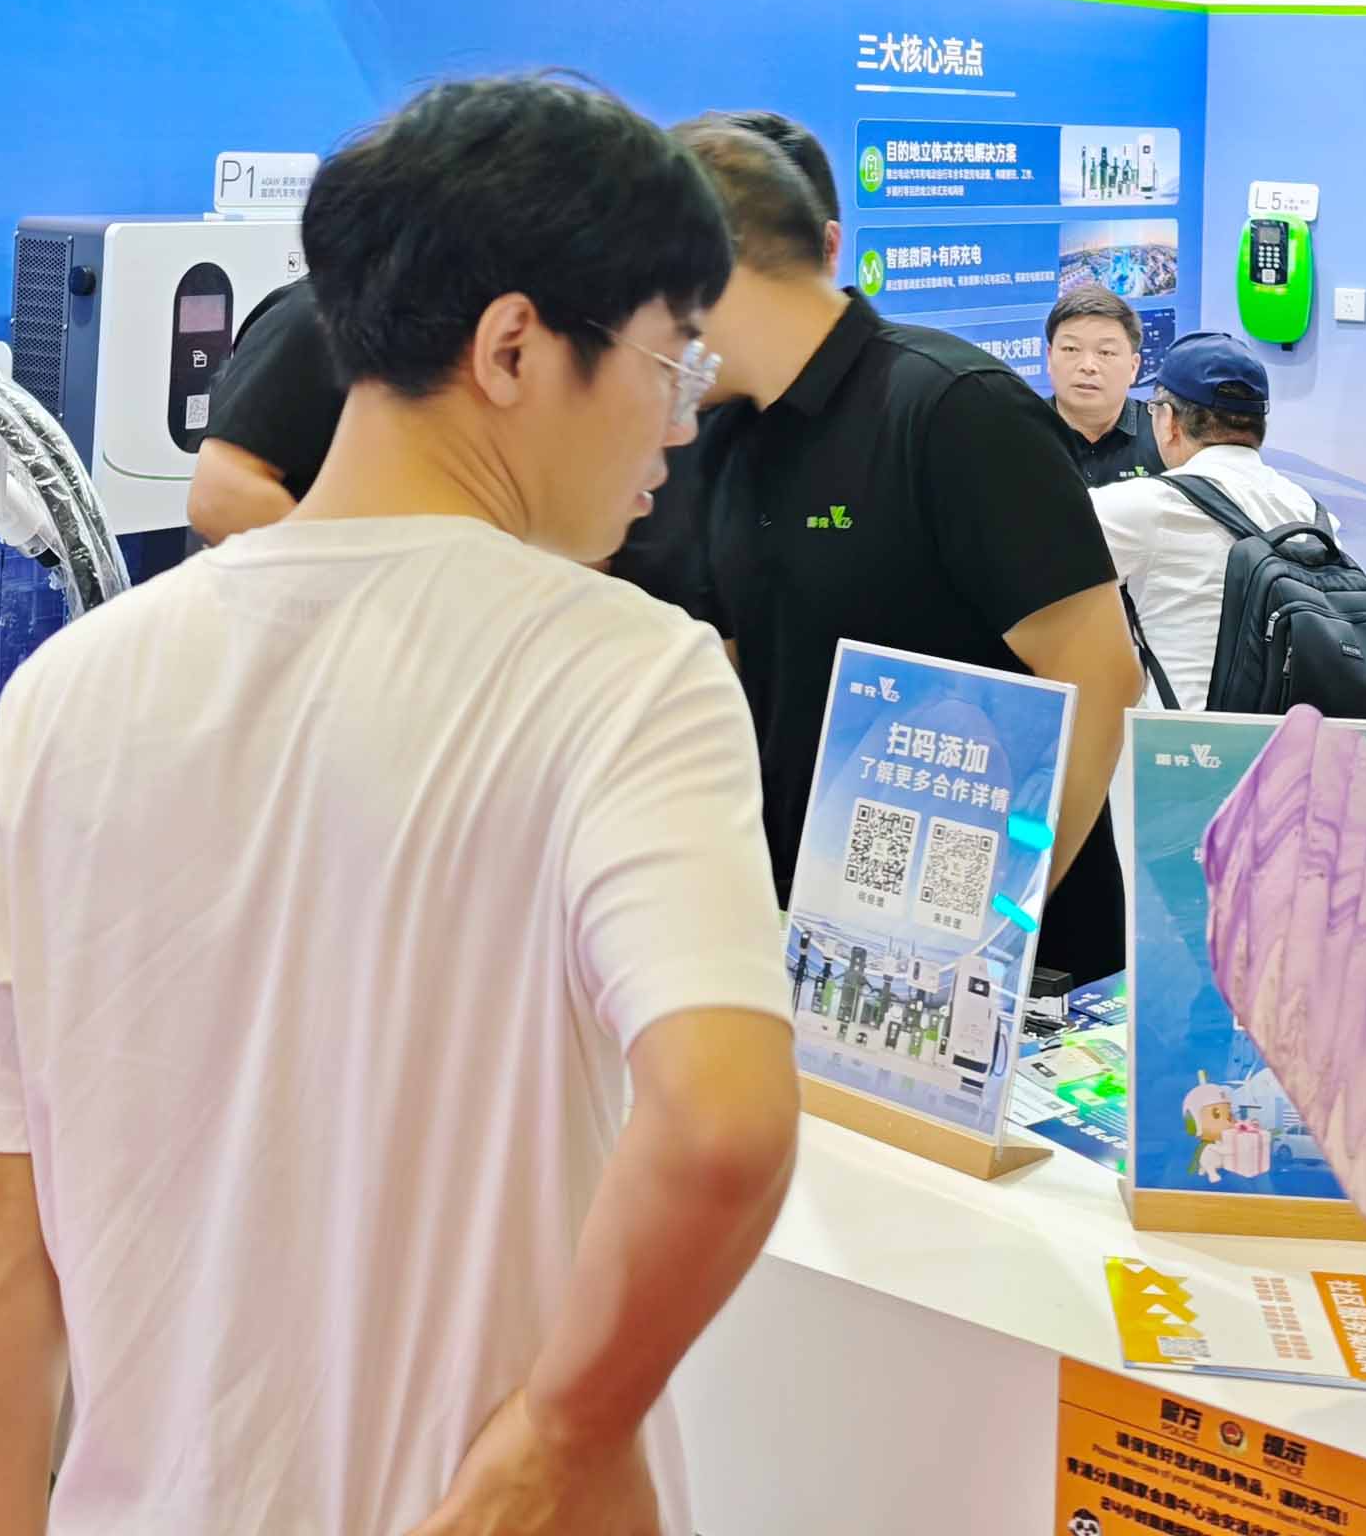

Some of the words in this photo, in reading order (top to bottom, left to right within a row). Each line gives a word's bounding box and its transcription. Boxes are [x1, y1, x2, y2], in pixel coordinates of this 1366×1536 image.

[857, 33, 984, 77] 三大核心亮点
[886, 141, 1017, 163] 目的地立体式充电解决方案
[221, 160, 254, 198] P1
[1254, 187, 1283, 210] L5
[887, 722, 990, 774] 扫码添加
[860, 756, 1010, 813] 了解更多合作详情
[1263, 1432, 1307, 1466] 提示
